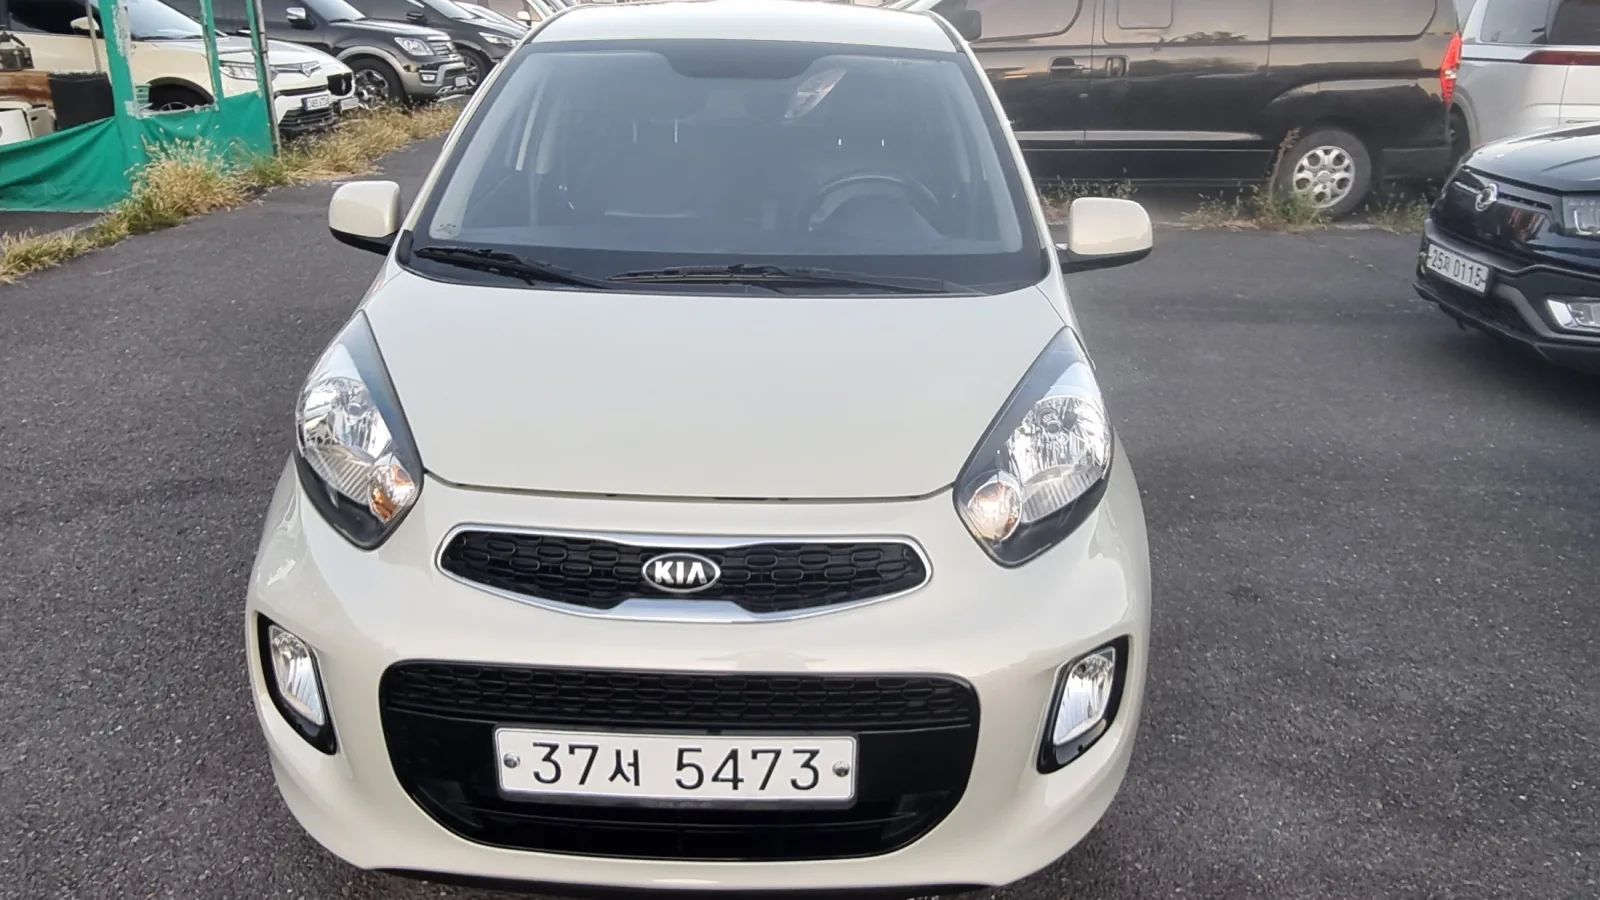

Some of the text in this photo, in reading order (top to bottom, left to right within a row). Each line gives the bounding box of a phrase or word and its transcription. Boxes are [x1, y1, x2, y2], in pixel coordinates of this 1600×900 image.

[1453, 259, 1482, 287] 0115
[654, 561, 708, 585] KIA
[532, 741, 821, 791] 37서 5473
